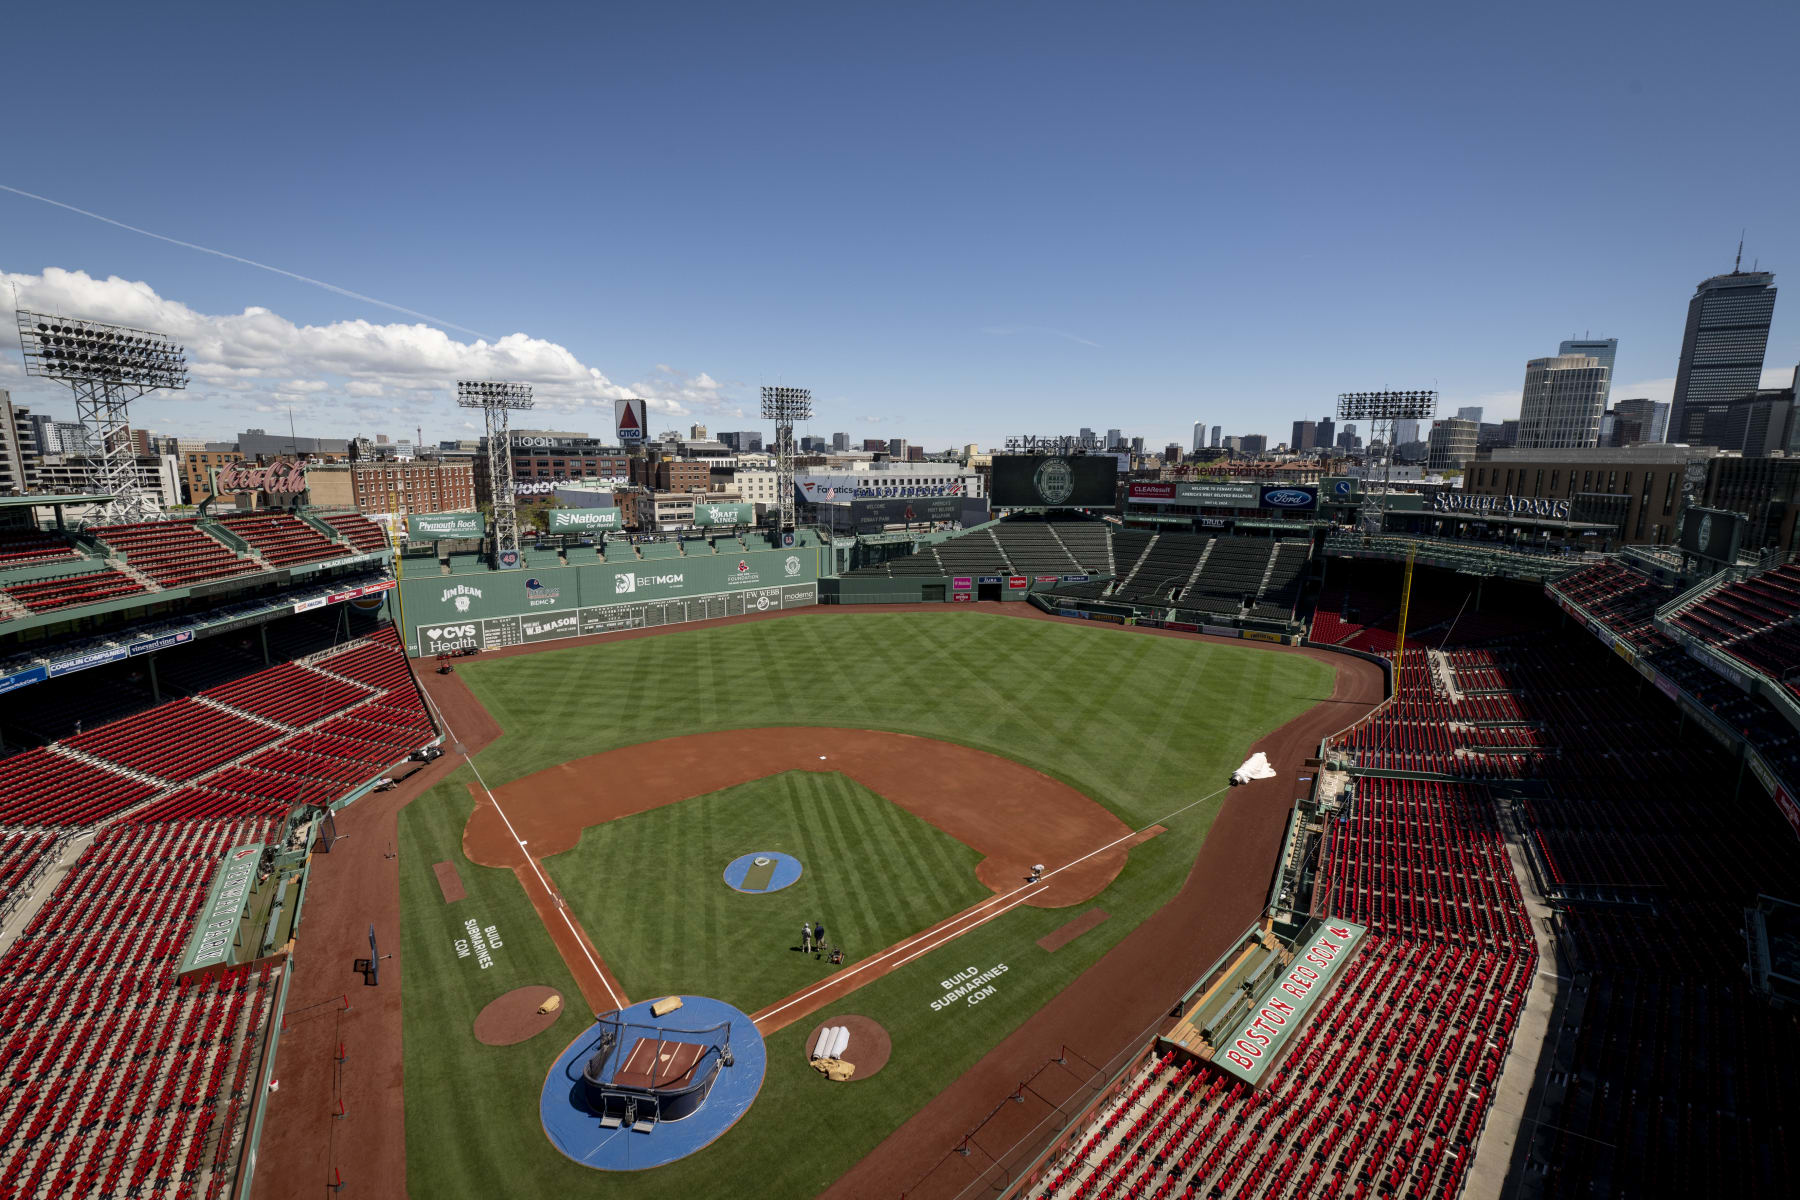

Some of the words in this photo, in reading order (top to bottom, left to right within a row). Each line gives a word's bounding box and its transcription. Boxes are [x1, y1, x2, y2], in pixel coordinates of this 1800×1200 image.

[619, 430, 640, 438] CITGO
[1024, 435, 1106, 449] MassMutual
[817, 485, 853, 494] Faatics
[854, 488, 882, 498] BANK
[885, 488, 898, 498] OF
[899, 487, 943, 497] AMERICA
[1273, 492, 1302, 505] Ford
[1434, 492, 1500, 511] SAMUEL
[1504, 494, 1570, 518] ADAMS
[570, 512, 615, 524] National
[709, 511, 738, 520] DRAFT
[418, 521, 456, 530] Plymouth
[458, 520, 477, 528] Rock
[637, 574, 684, 587] BETMGM
[442, 588, 458, 602] JIM
[458, 585, 482, 599] BEAM
[760, 589, 780, 597] WEBB
[442, 624, 476, 639] CVS
[132, 640, 160, 653] vineyard
[160, 638, 176, 646] vines
[430, 637, 478, 653] Health
[50, 658, 84, 672] COGHLIN
[84, 649, 126, 664] COMPANIES
[212, 862, 253, 918] FENWAY
[194, 918, 234, 965] PARK
[464, 918, 494, 970] SUBMARINES
[484, 925, 503, 949] BUILD
[454, 939, 470, 959] .COM
[940, 966, 978, 990] BUILD
[930, 963, 1009, 1011] SUBMARINES
[968, 985, 997, 1008] .COM
[1226, 996, 1296, 1072] BOSTON
[1280, 965, 1320, 1000] RED
[1306, 937, 1344, 970] SOX
